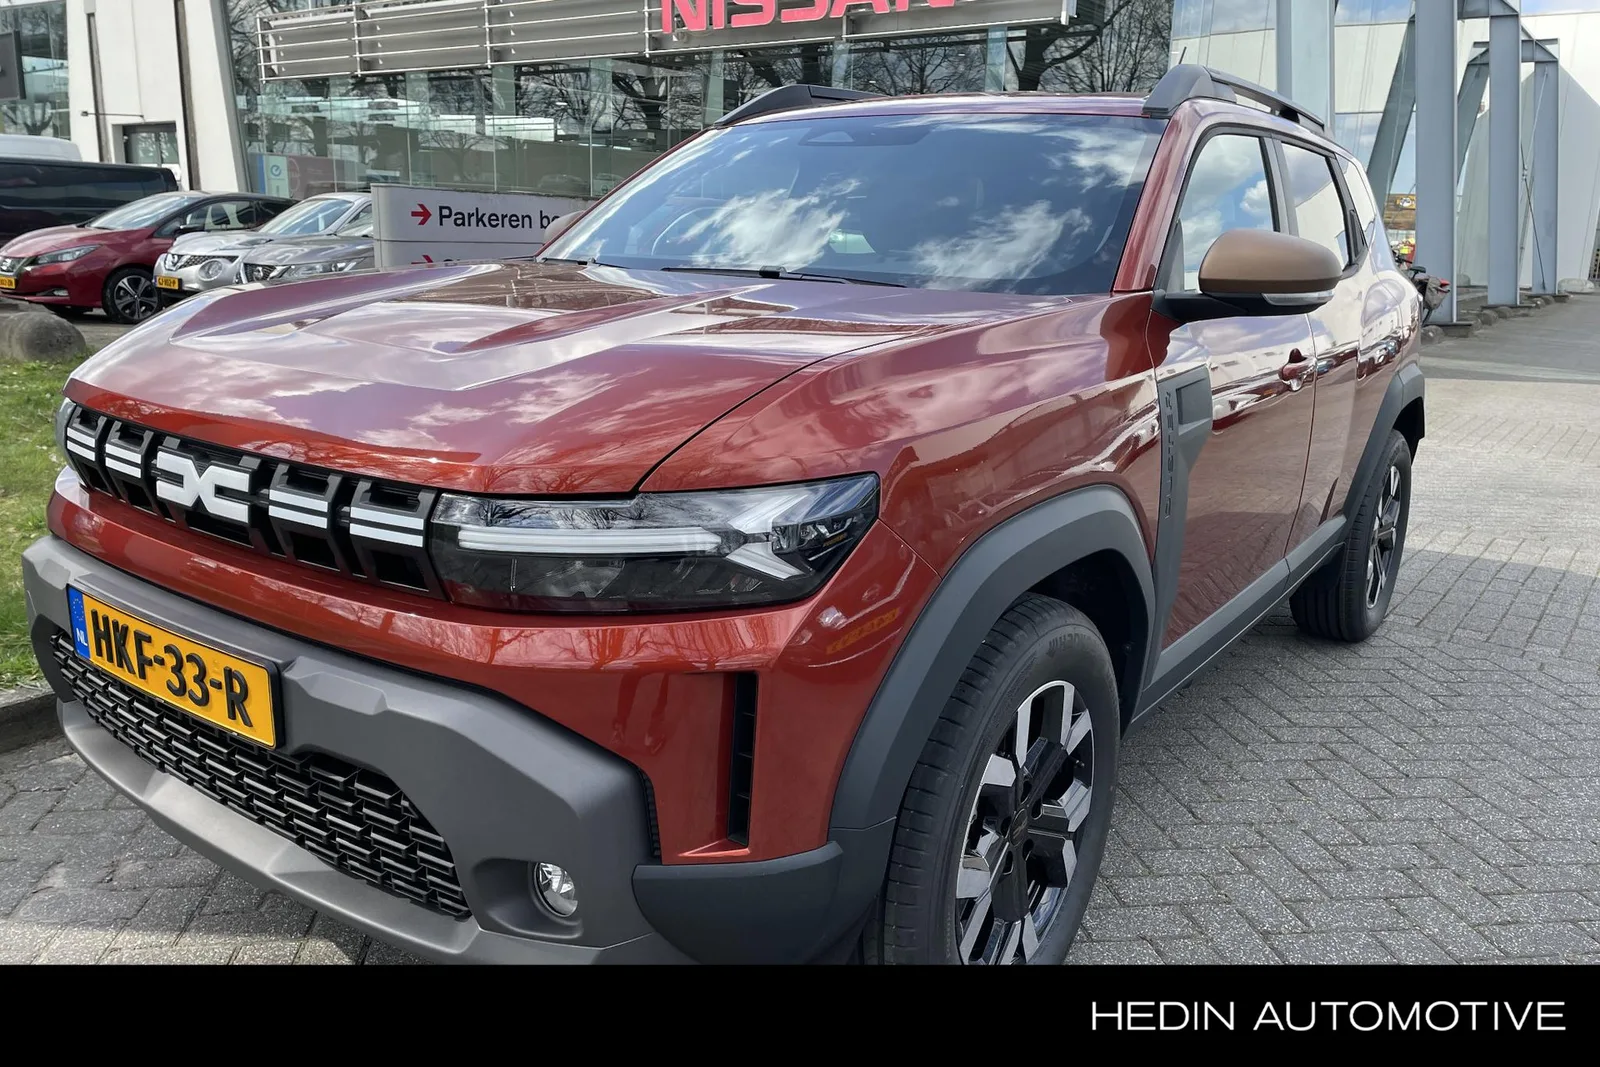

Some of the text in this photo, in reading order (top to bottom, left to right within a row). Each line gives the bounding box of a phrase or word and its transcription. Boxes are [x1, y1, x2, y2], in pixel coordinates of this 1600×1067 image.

[661, 0, 955, 34] NIS
[439, 205, 561, 229] Parkeren b
[1164, 391, 1175, 519] DUSTER
[76, 608, 253, 727] NL HKF-33-R
